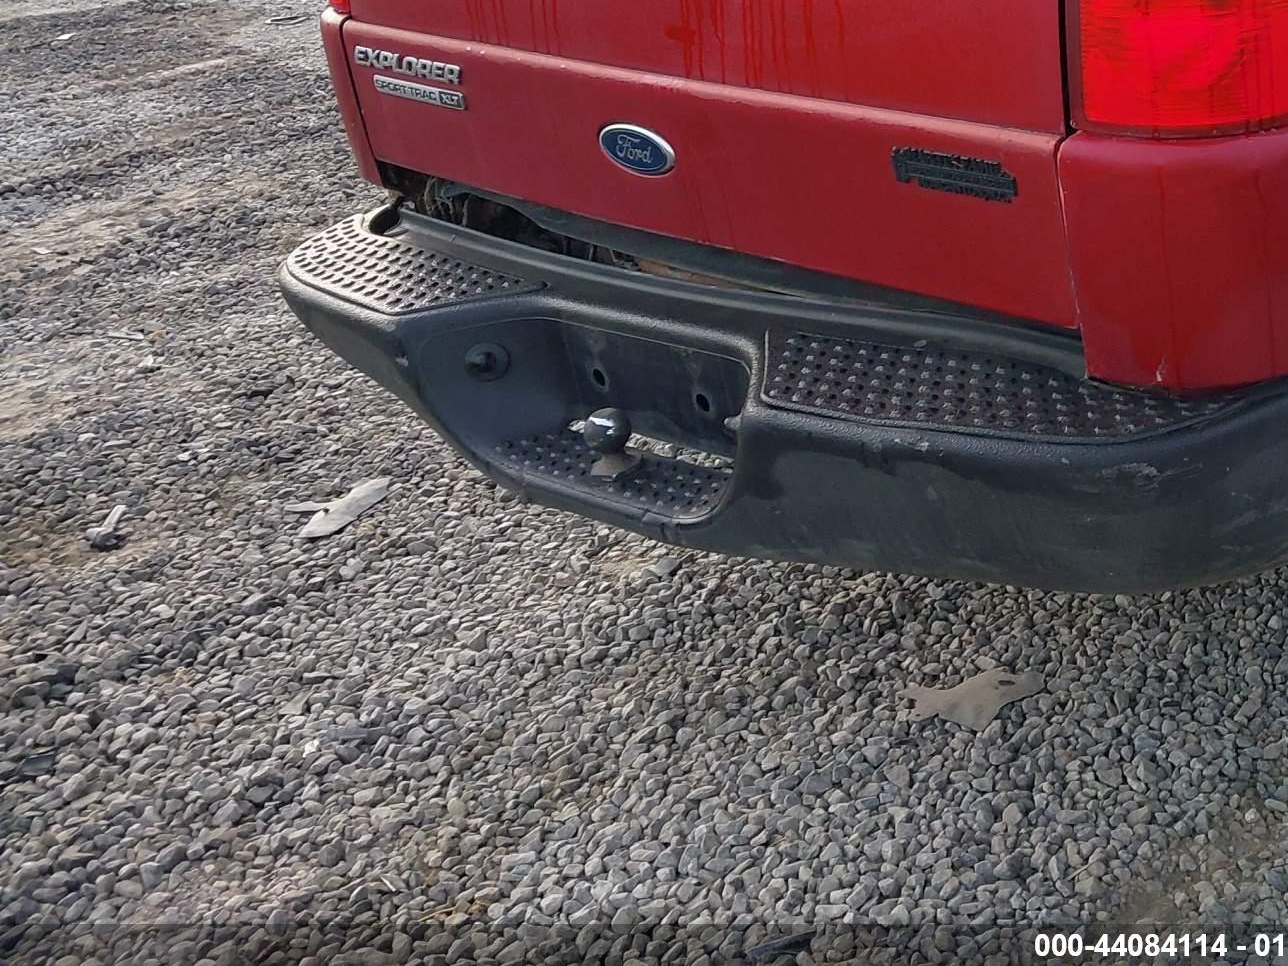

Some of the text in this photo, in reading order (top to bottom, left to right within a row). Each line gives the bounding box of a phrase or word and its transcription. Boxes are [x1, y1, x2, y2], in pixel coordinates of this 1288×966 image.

[354, 45, 461, 85] EXPLORER
[375, 79, 459, 106] SPORT TRAC XLT
[616, 134, 653, 163] Ford
